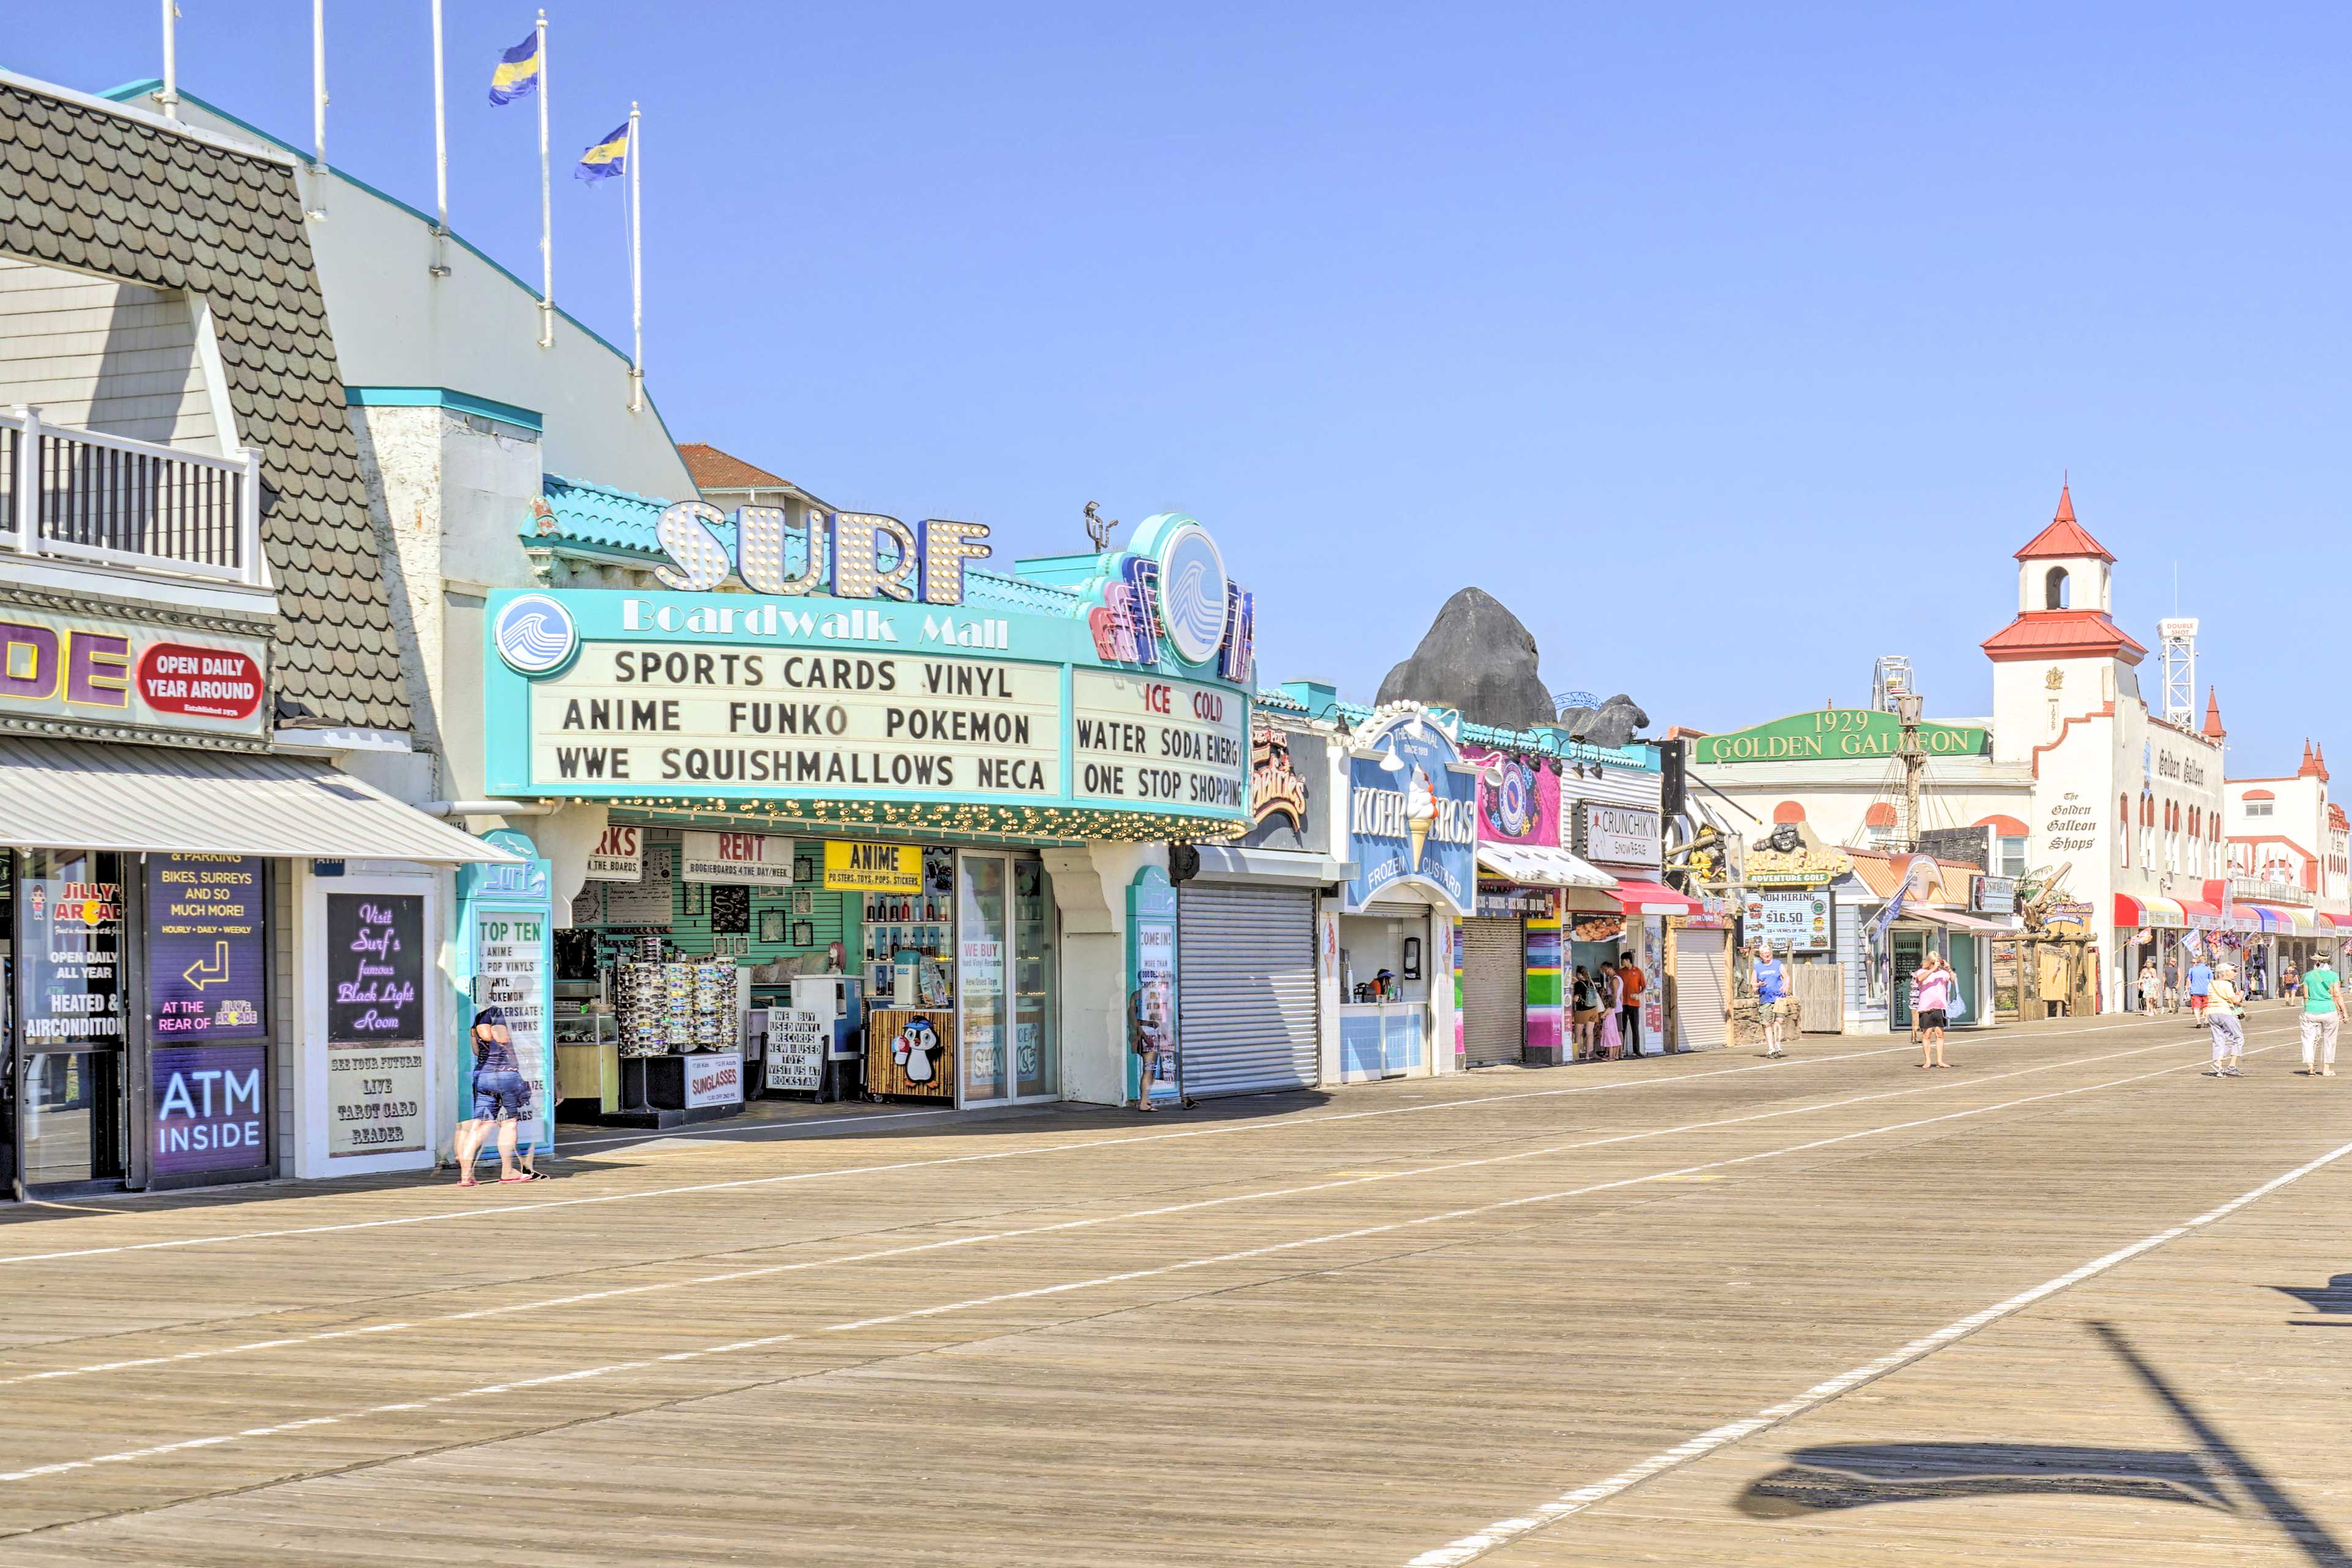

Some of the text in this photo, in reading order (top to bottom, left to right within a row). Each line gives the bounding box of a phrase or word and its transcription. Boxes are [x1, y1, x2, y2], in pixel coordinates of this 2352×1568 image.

[654, 500, 992, 605] SURF
[622, 598, 1009, 650] Boardwalk Mall
[157, 655, 246, 676] OPEN DAILY
[614, 650, 1012, 698] SPORTS CARDS VINYL
[146, 679, 254, 699] YEAR AROUND
[1145, 683, 1223, 723] ICE COLD
[562, 698, 1029, 745] ANIME FUNKO POKEMON
[1814, 711, 1869, 734] 1929
[1076, 719, 1242, 767] WATER SODA ENERGY
[1713, 735, 1823, 760] GOLDEN
[556, 747, 1046, 790] WWE SQUISHMALLOWS NECA
[1084, 763, 1124, 794] ONE
[1138, 768, 1182, 799] STOP
[1190, 773, 1242, 807] SHOPPING
[2063, 792, 2079, 801] The
[1352, 786, 1408, 839] KOHR
[2051, 805, 2092, 816] Golden
[1602, 810, 1657, 838] CRUNCHIK'N
[2046, 820, 2097, 832] Galleon
[719, 833, 765, 861] RENT
[2048, 837, 2095, 851] Shops
[594, 861, 607, 870] THE
[610, 861, 637, 872] BOARDS
[850, 844, 899, 871] ANIME
[162, 871, 252, 884] BIKES, SURREYS
[690, 863, 737, 875] BOOGIEBOARDS
[744, 867, 755, 875] THE
[1368, 855, 1461, 899] FROZEN CUSTARD
[185, 888, 230, 900] AND SO
[1760, 892, 1815, 902] NOW HIRING
[171, 905, 244, 916] MUCH MORE!
[359, 903, 393, 924] Visit
[1766, 913, 1803, 923] $16.50
[479, 921, 541, 941] TOP TEN
[50, 952, 118, 963] OPEN DAILY
[487, 946, 513, 957] ANIME
[965, 943, 997, 957] WE BUY
[56, 967, 113, 979] ALL YEAR
[358, 958, 395, 982] famous
[488, 962, 502, 972] POP
[506, 961, 535, 972] VINYLS
[51, 993, 119, 1012] HEATED &
[337, 981, 415, 1009] Black Light
[162, 1001, 205, 1013] AT THE
[775, 1011, 815, 1022] WE BUY
[159, 1018, 211, 1031] REAR OF
[353, 1009, 399, 1031] Room
[770, 1022, 821, 1033] USED VINYL
[776, 1033, 815, 1043] RECORDS
[769, 1043, 788, 1053] NEW
[798, 1044, 821, 1054] USED
[331, 1055, 422, 1071] SEE YOUR FUTURE!
[782, 1054, 805, 1065] TOYS
[769, 1065, 820, 1076] VISIT US AT
[363, 1078, 393, 1095] LIVE
[693, 1069, 737, 1095] SUNGLASSES
[772, 1075, 818, 1087] ROCKSTAR
[159, 1068, 260, 1121] ATM
[337, 1101, 418, 1121] TAROT CARD
[159, 1121, 260, 1153] INSIDE
[352, 1126, 404, 1145] READER
